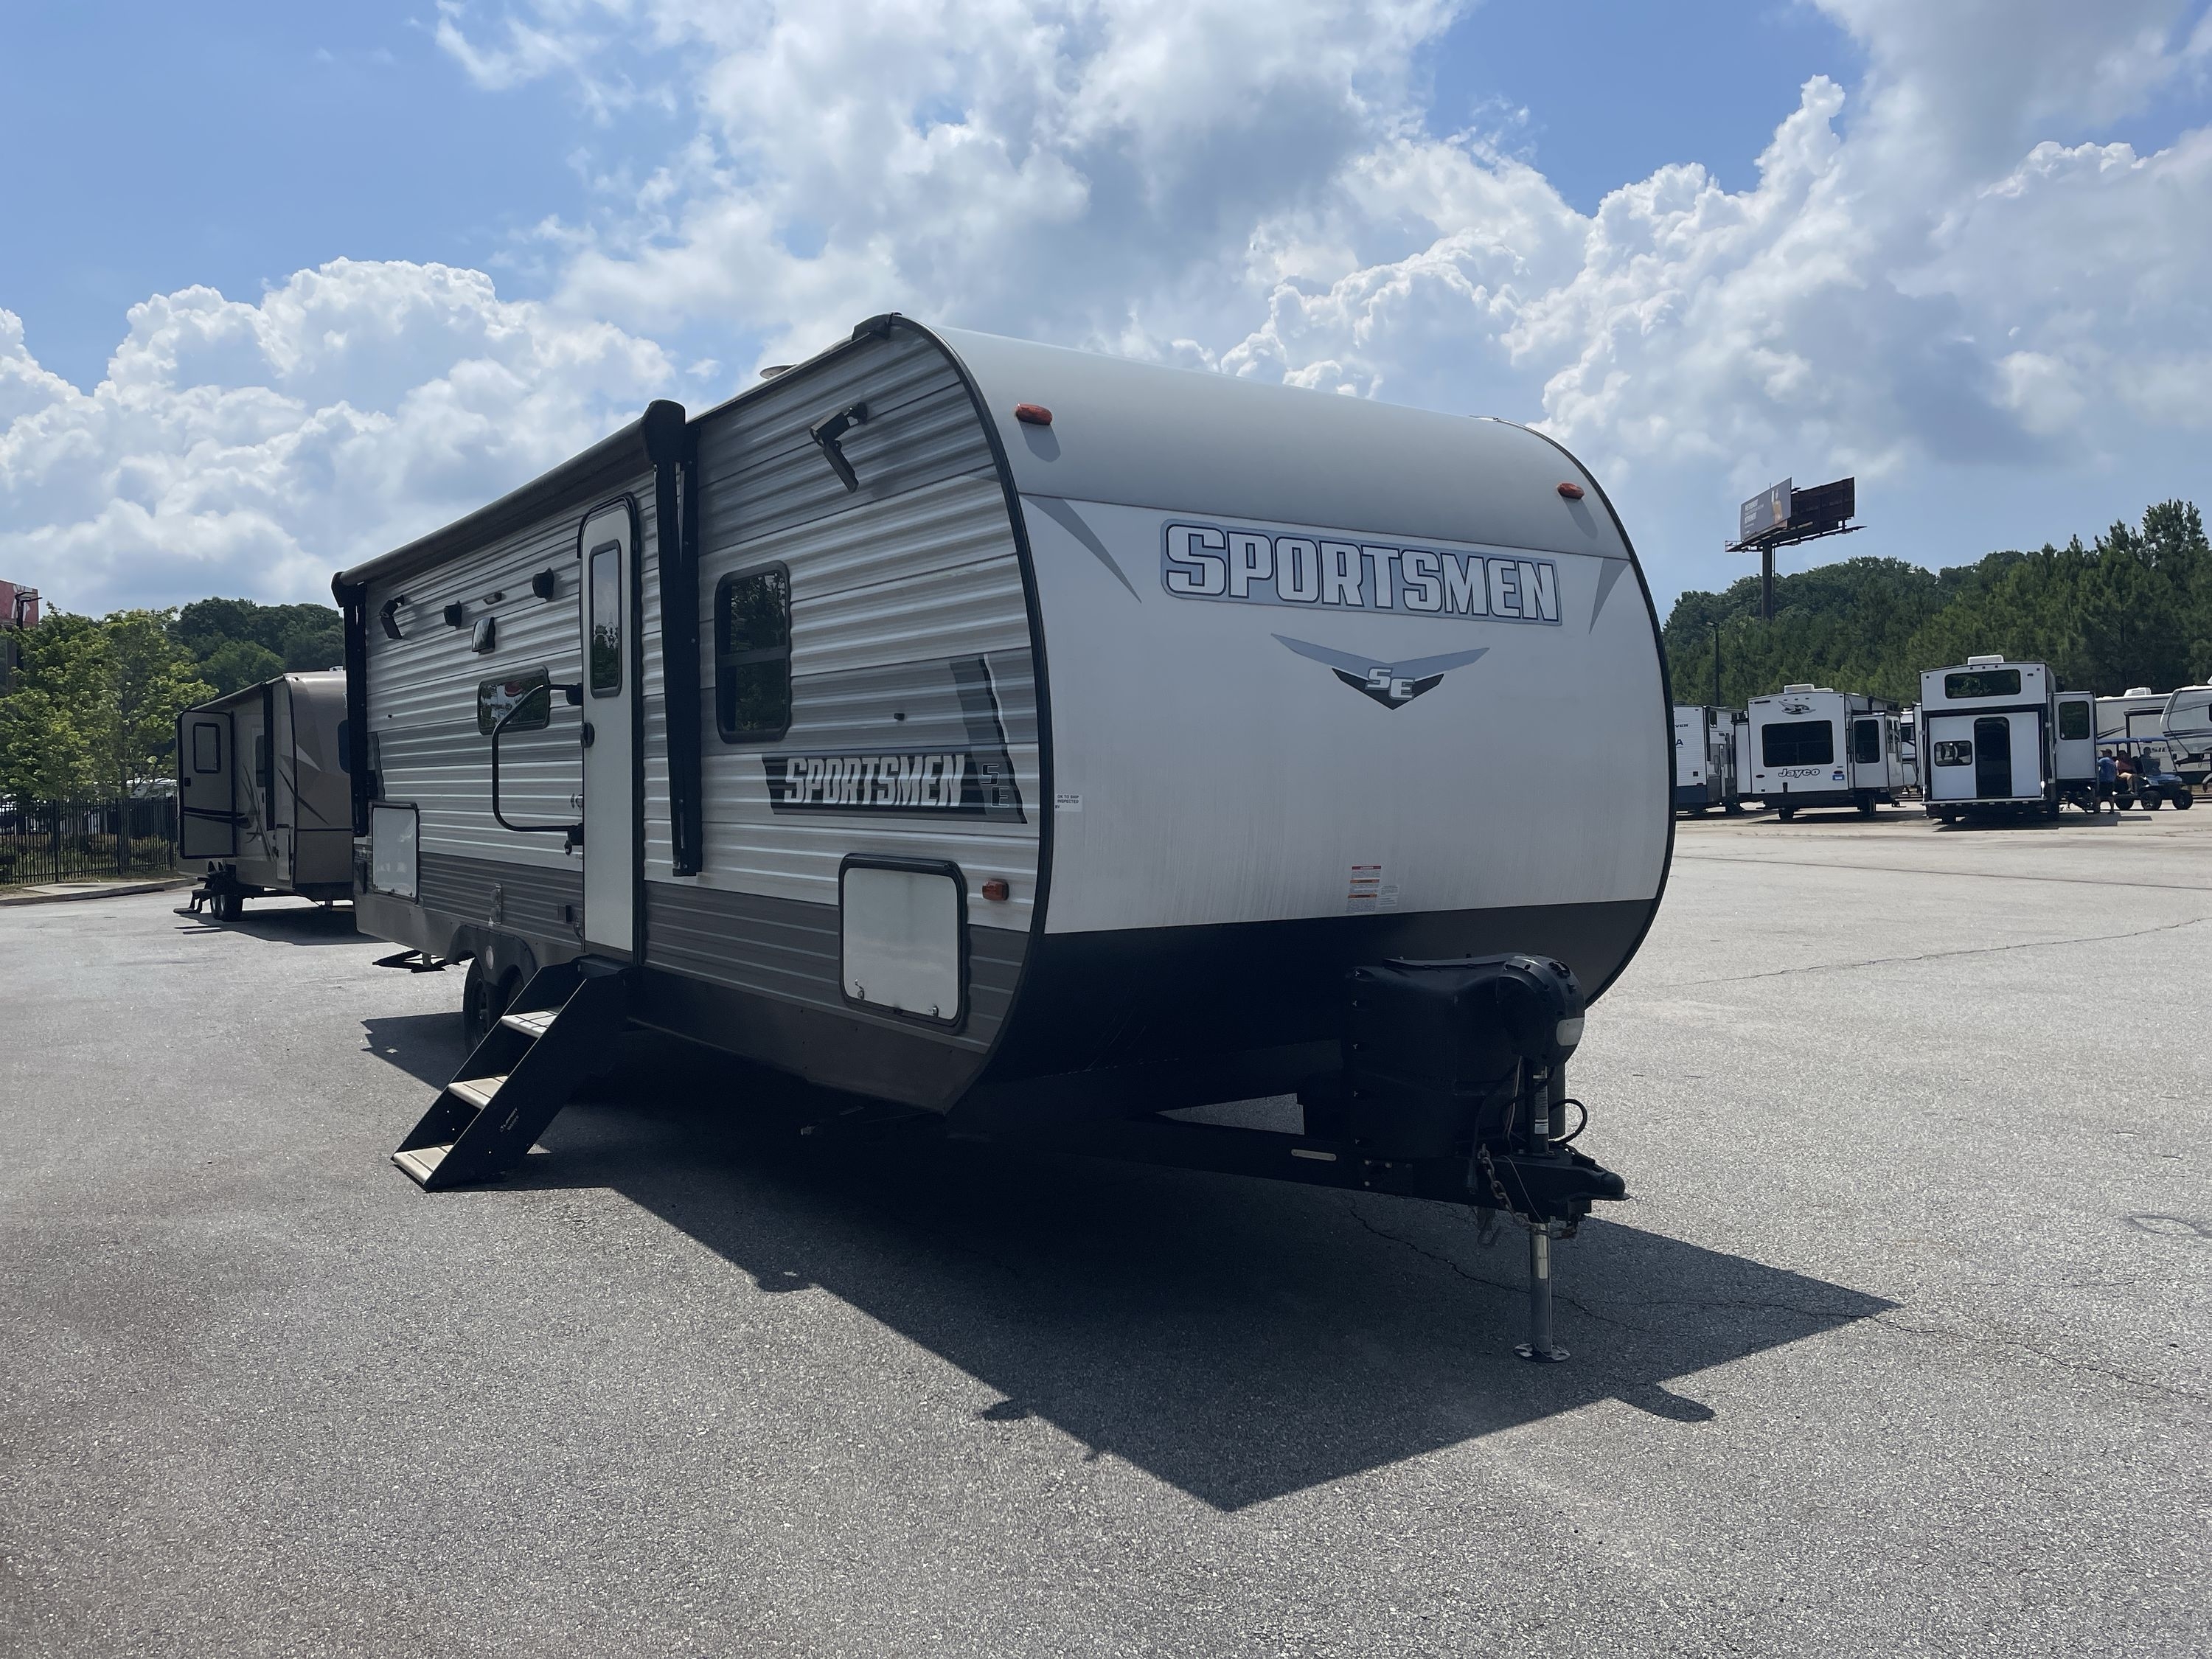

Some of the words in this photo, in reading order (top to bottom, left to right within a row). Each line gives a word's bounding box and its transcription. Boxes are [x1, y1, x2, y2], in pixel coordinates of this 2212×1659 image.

[1166, 524, 1559, 622] SPORTSMEN
[1365, 666, 1415, 701] SE
[784, 754, 964, 808] SPORTSMEN
[1778, 768, 1820, 779] Jayco
